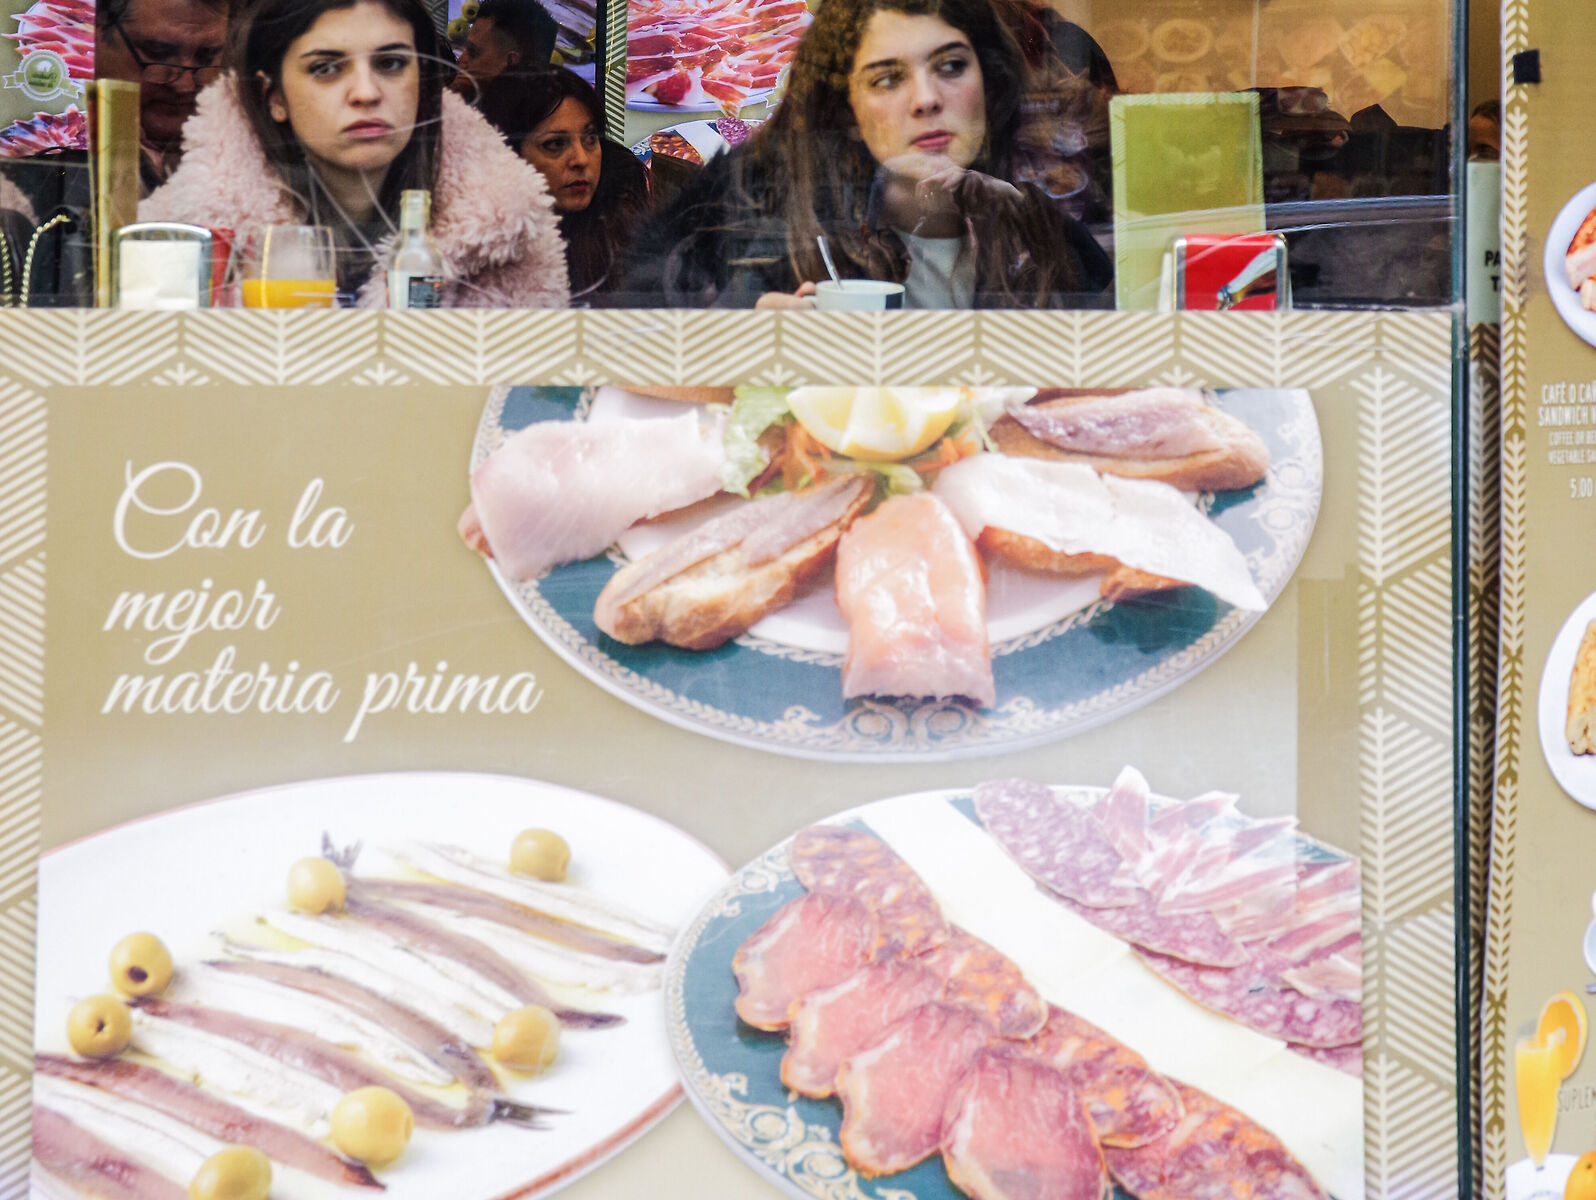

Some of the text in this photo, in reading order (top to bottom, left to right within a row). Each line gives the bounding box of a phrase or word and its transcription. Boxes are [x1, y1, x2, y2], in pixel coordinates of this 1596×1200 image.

[1538, 405, 1588, 427] SANDWICH
[1541, 381, 1566, 404] CAFÉ
[113, 459, 355, 560] Con la
[102, 578, 282, 666] mejor
[101, 645, 545, 743] materia prima
